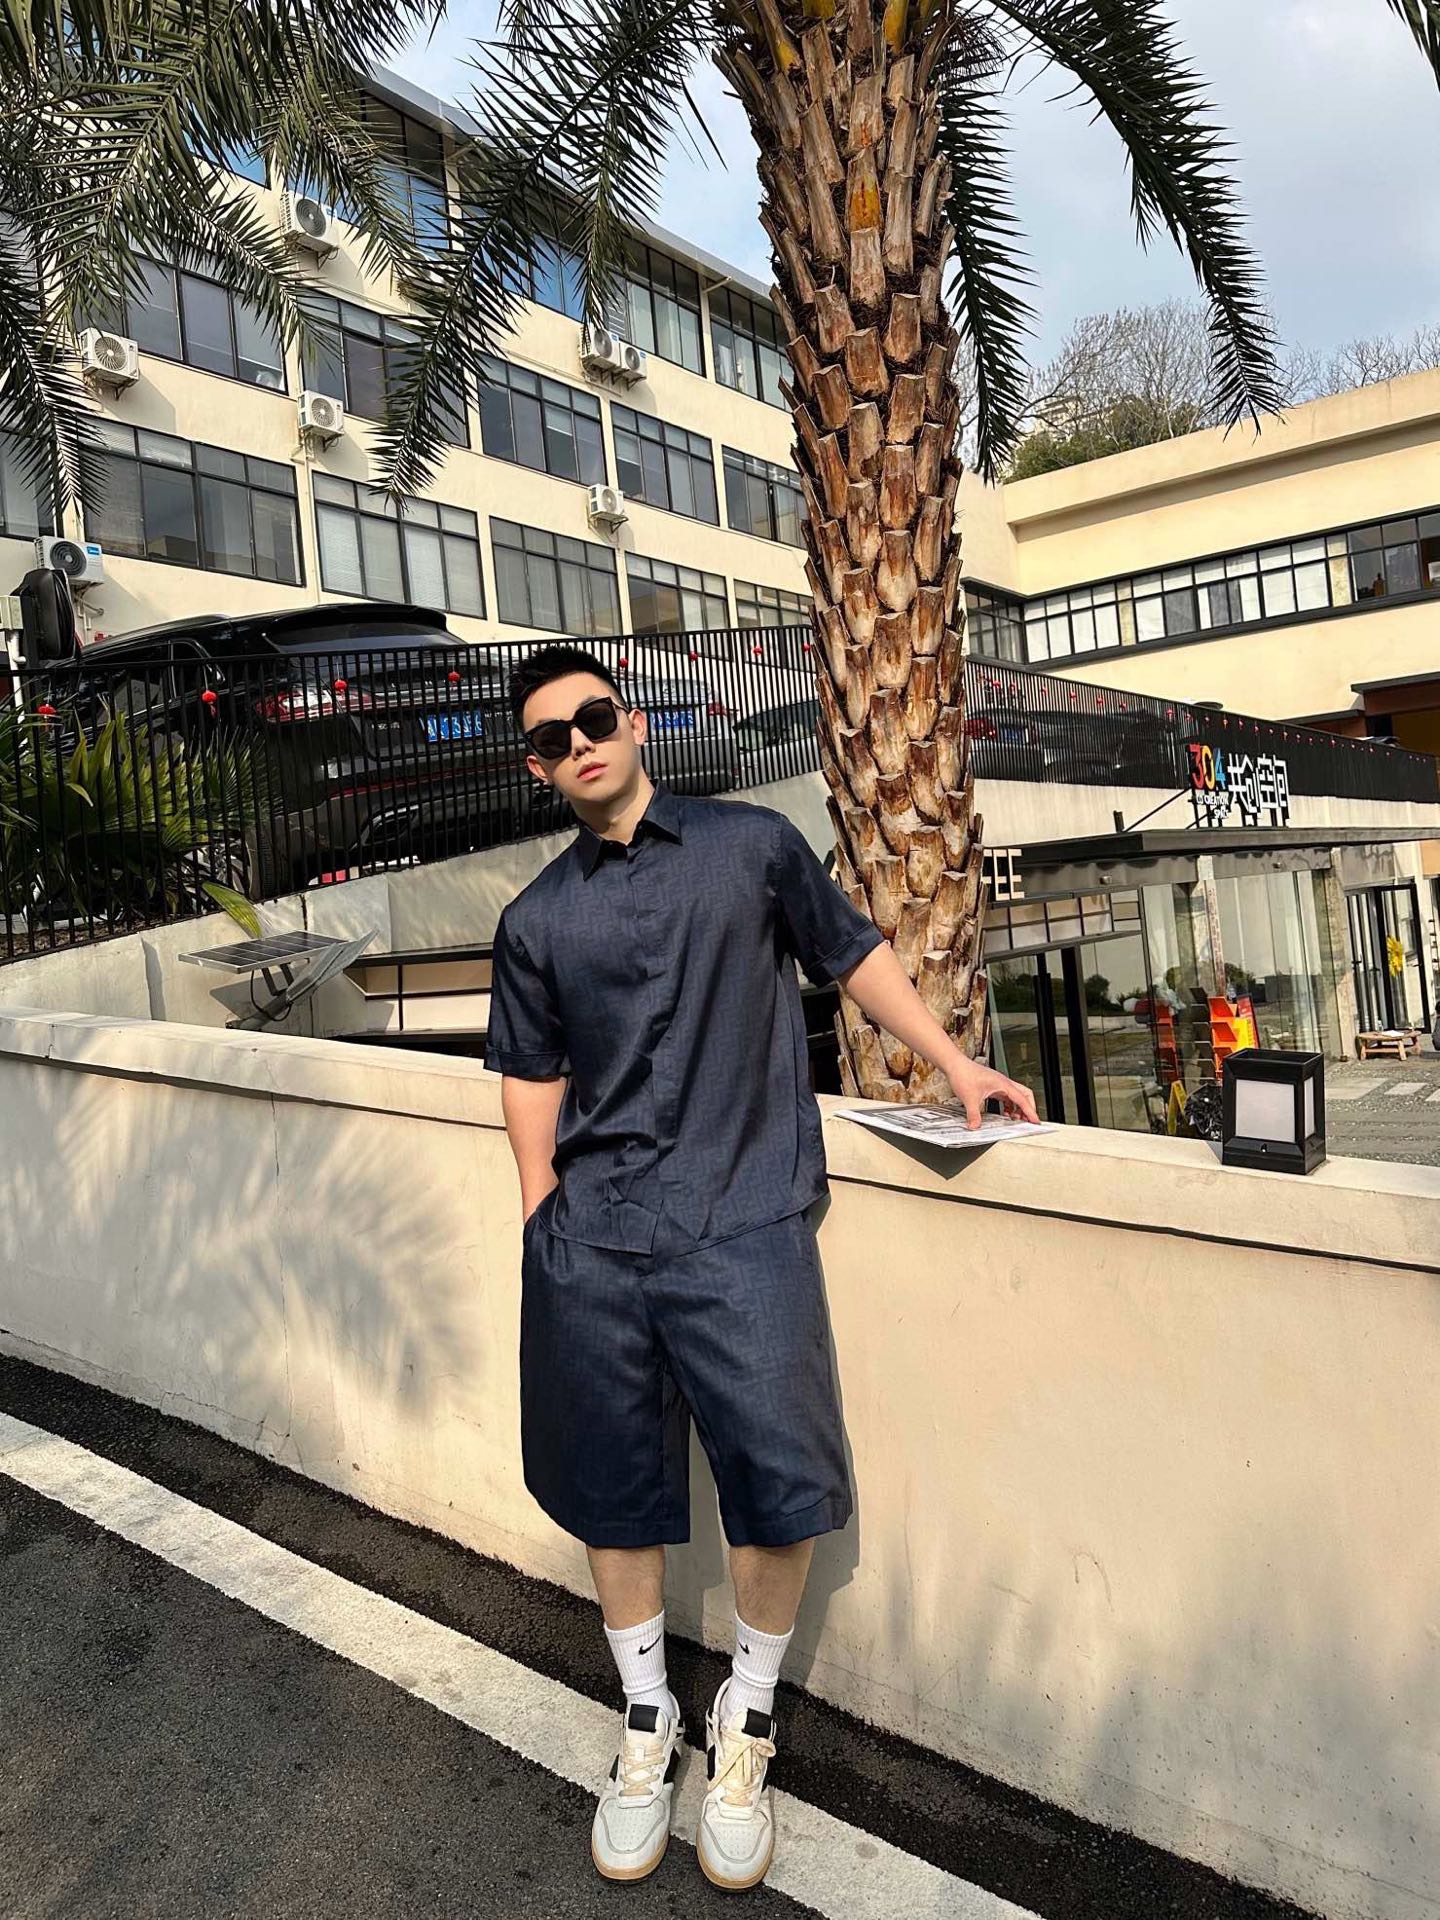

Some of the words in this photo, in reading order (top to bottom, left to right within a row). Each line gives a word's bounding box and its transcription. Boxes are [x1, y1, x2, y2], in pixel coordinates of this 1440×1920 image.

[1189, 743, 1226, 790] 304
[1227, 753, 1290, 818] 共创空间
